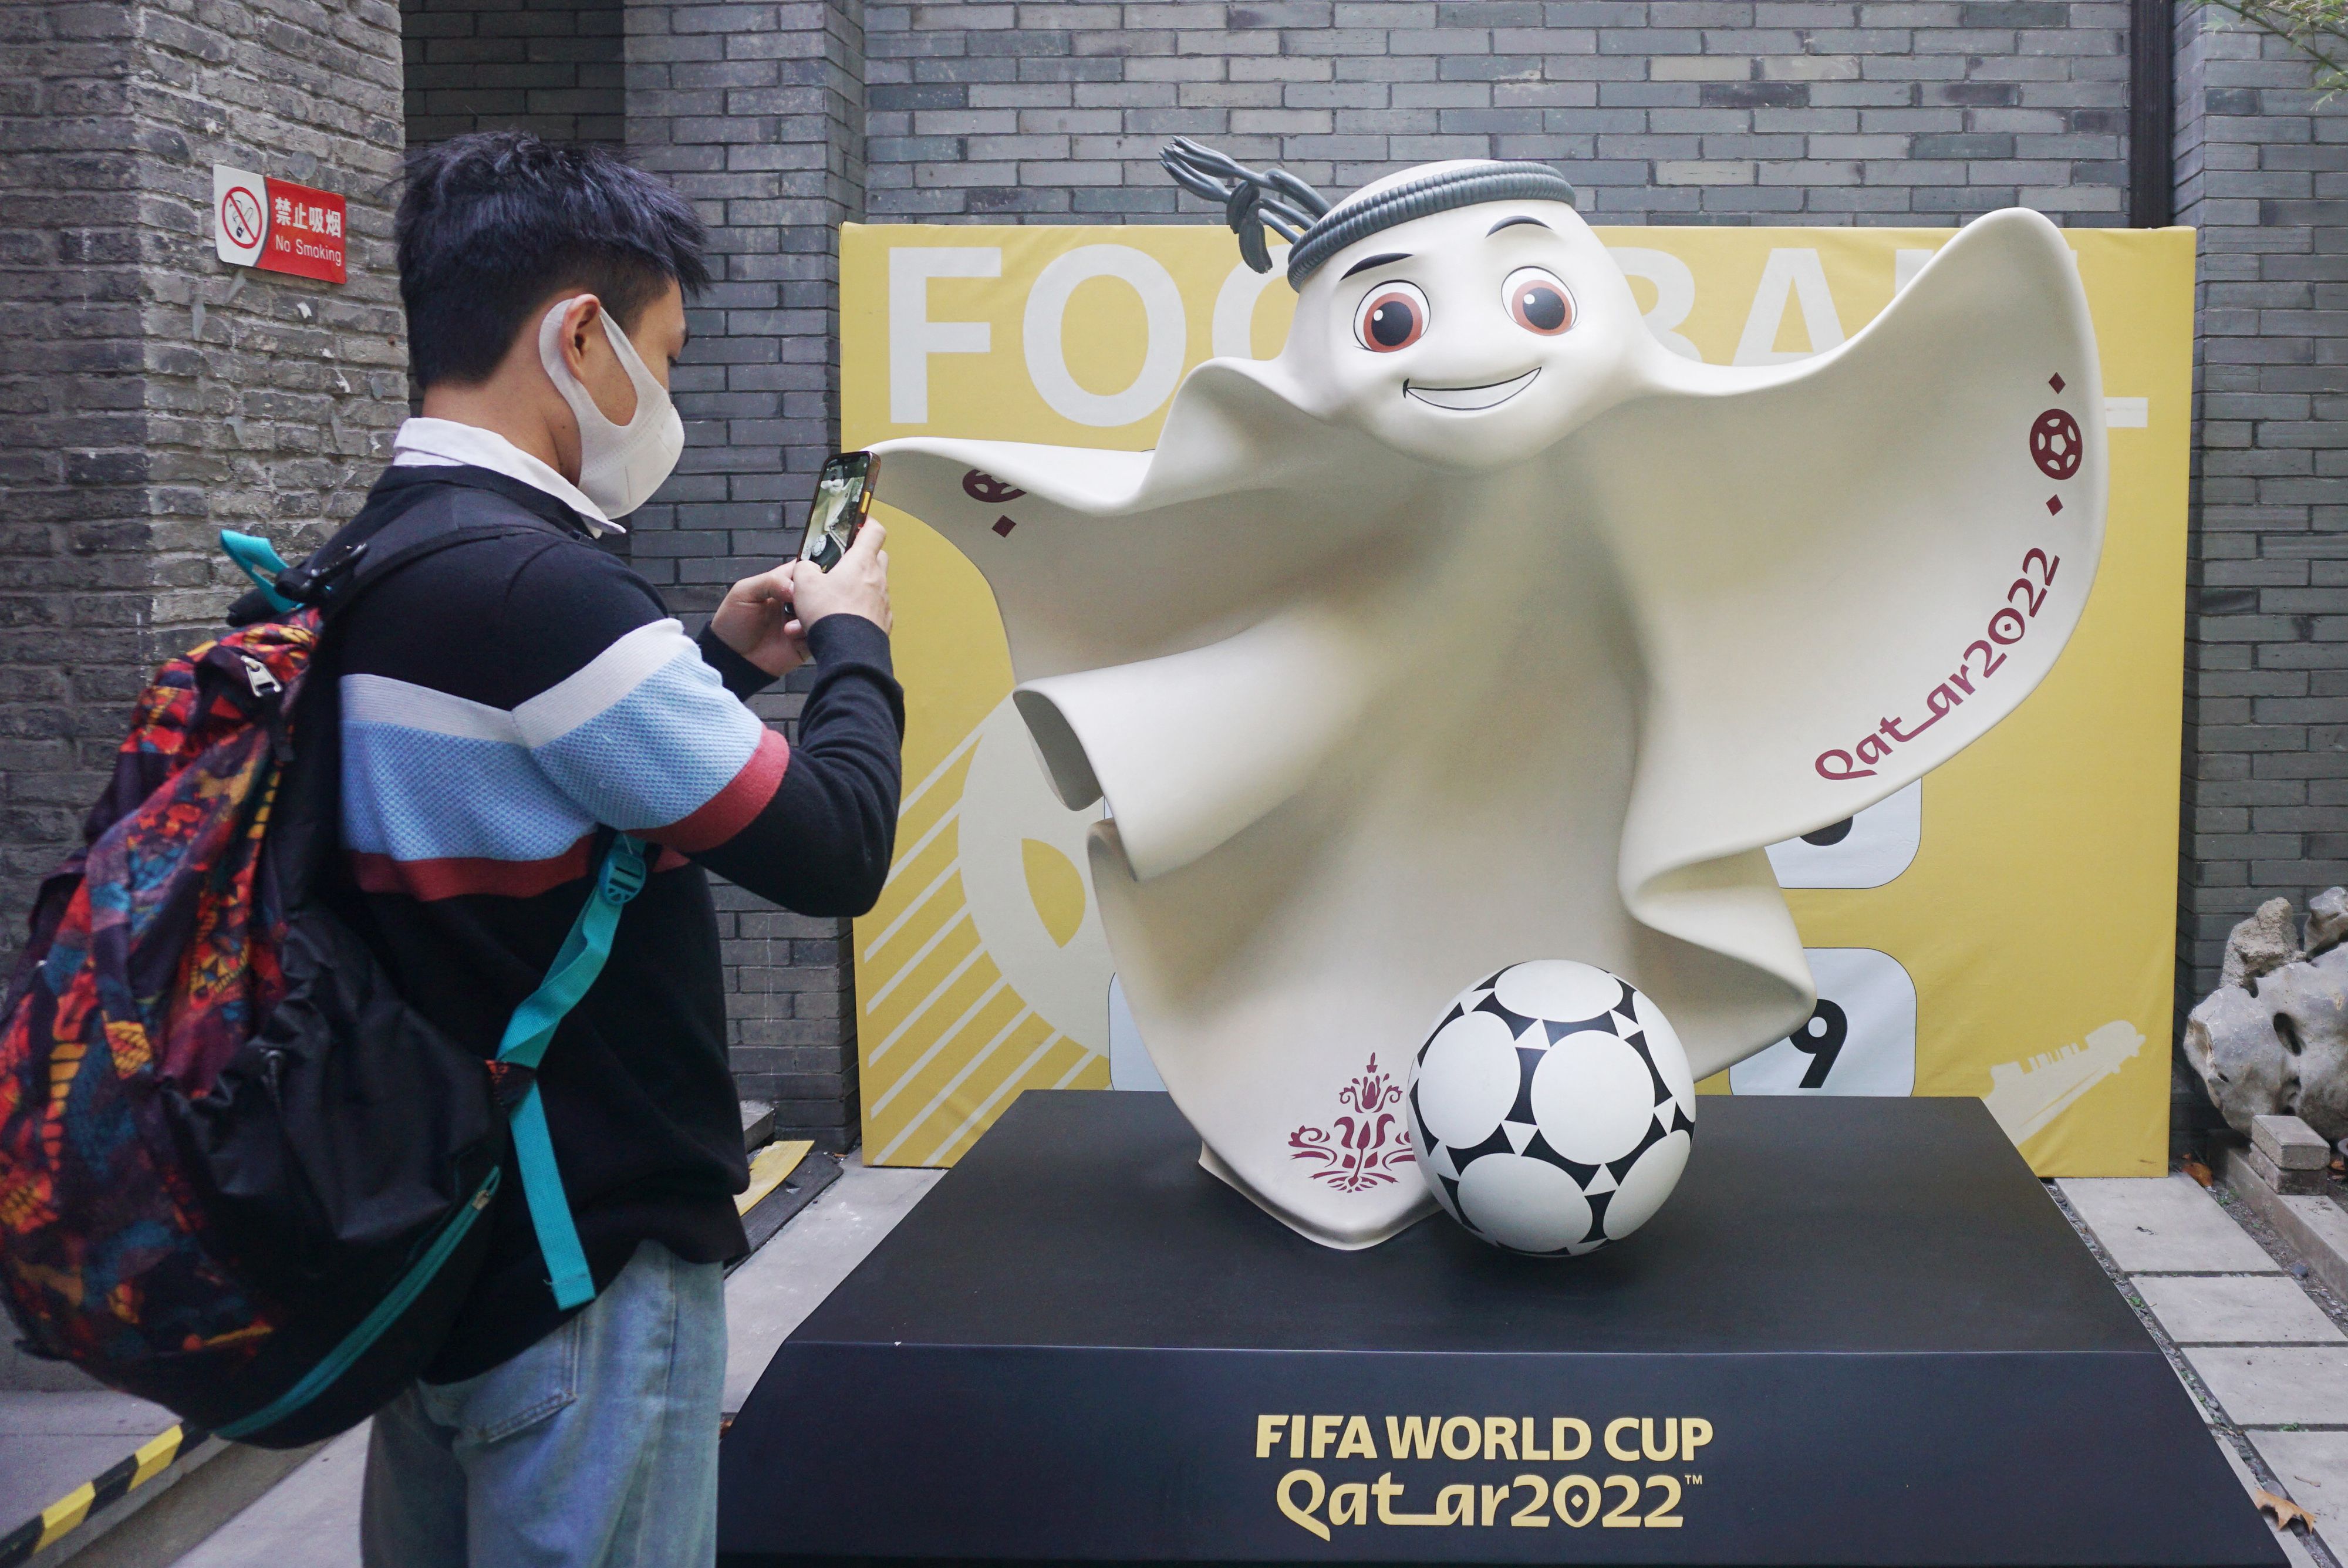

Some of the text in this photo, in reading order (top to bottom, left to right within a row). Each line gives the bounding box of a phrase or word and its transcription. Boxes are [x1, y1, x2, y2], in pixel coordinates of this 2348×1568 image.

[275, 197, 342, 238] 禁止吸烟
[275, 235, 342, 267] No Smoking
[1815, 548, 2060, 780] Qatar2022
[1789, 999, 1848, 1088] 9
[1255, 1414, 1714, 1462] FIFA WORLD CUP
